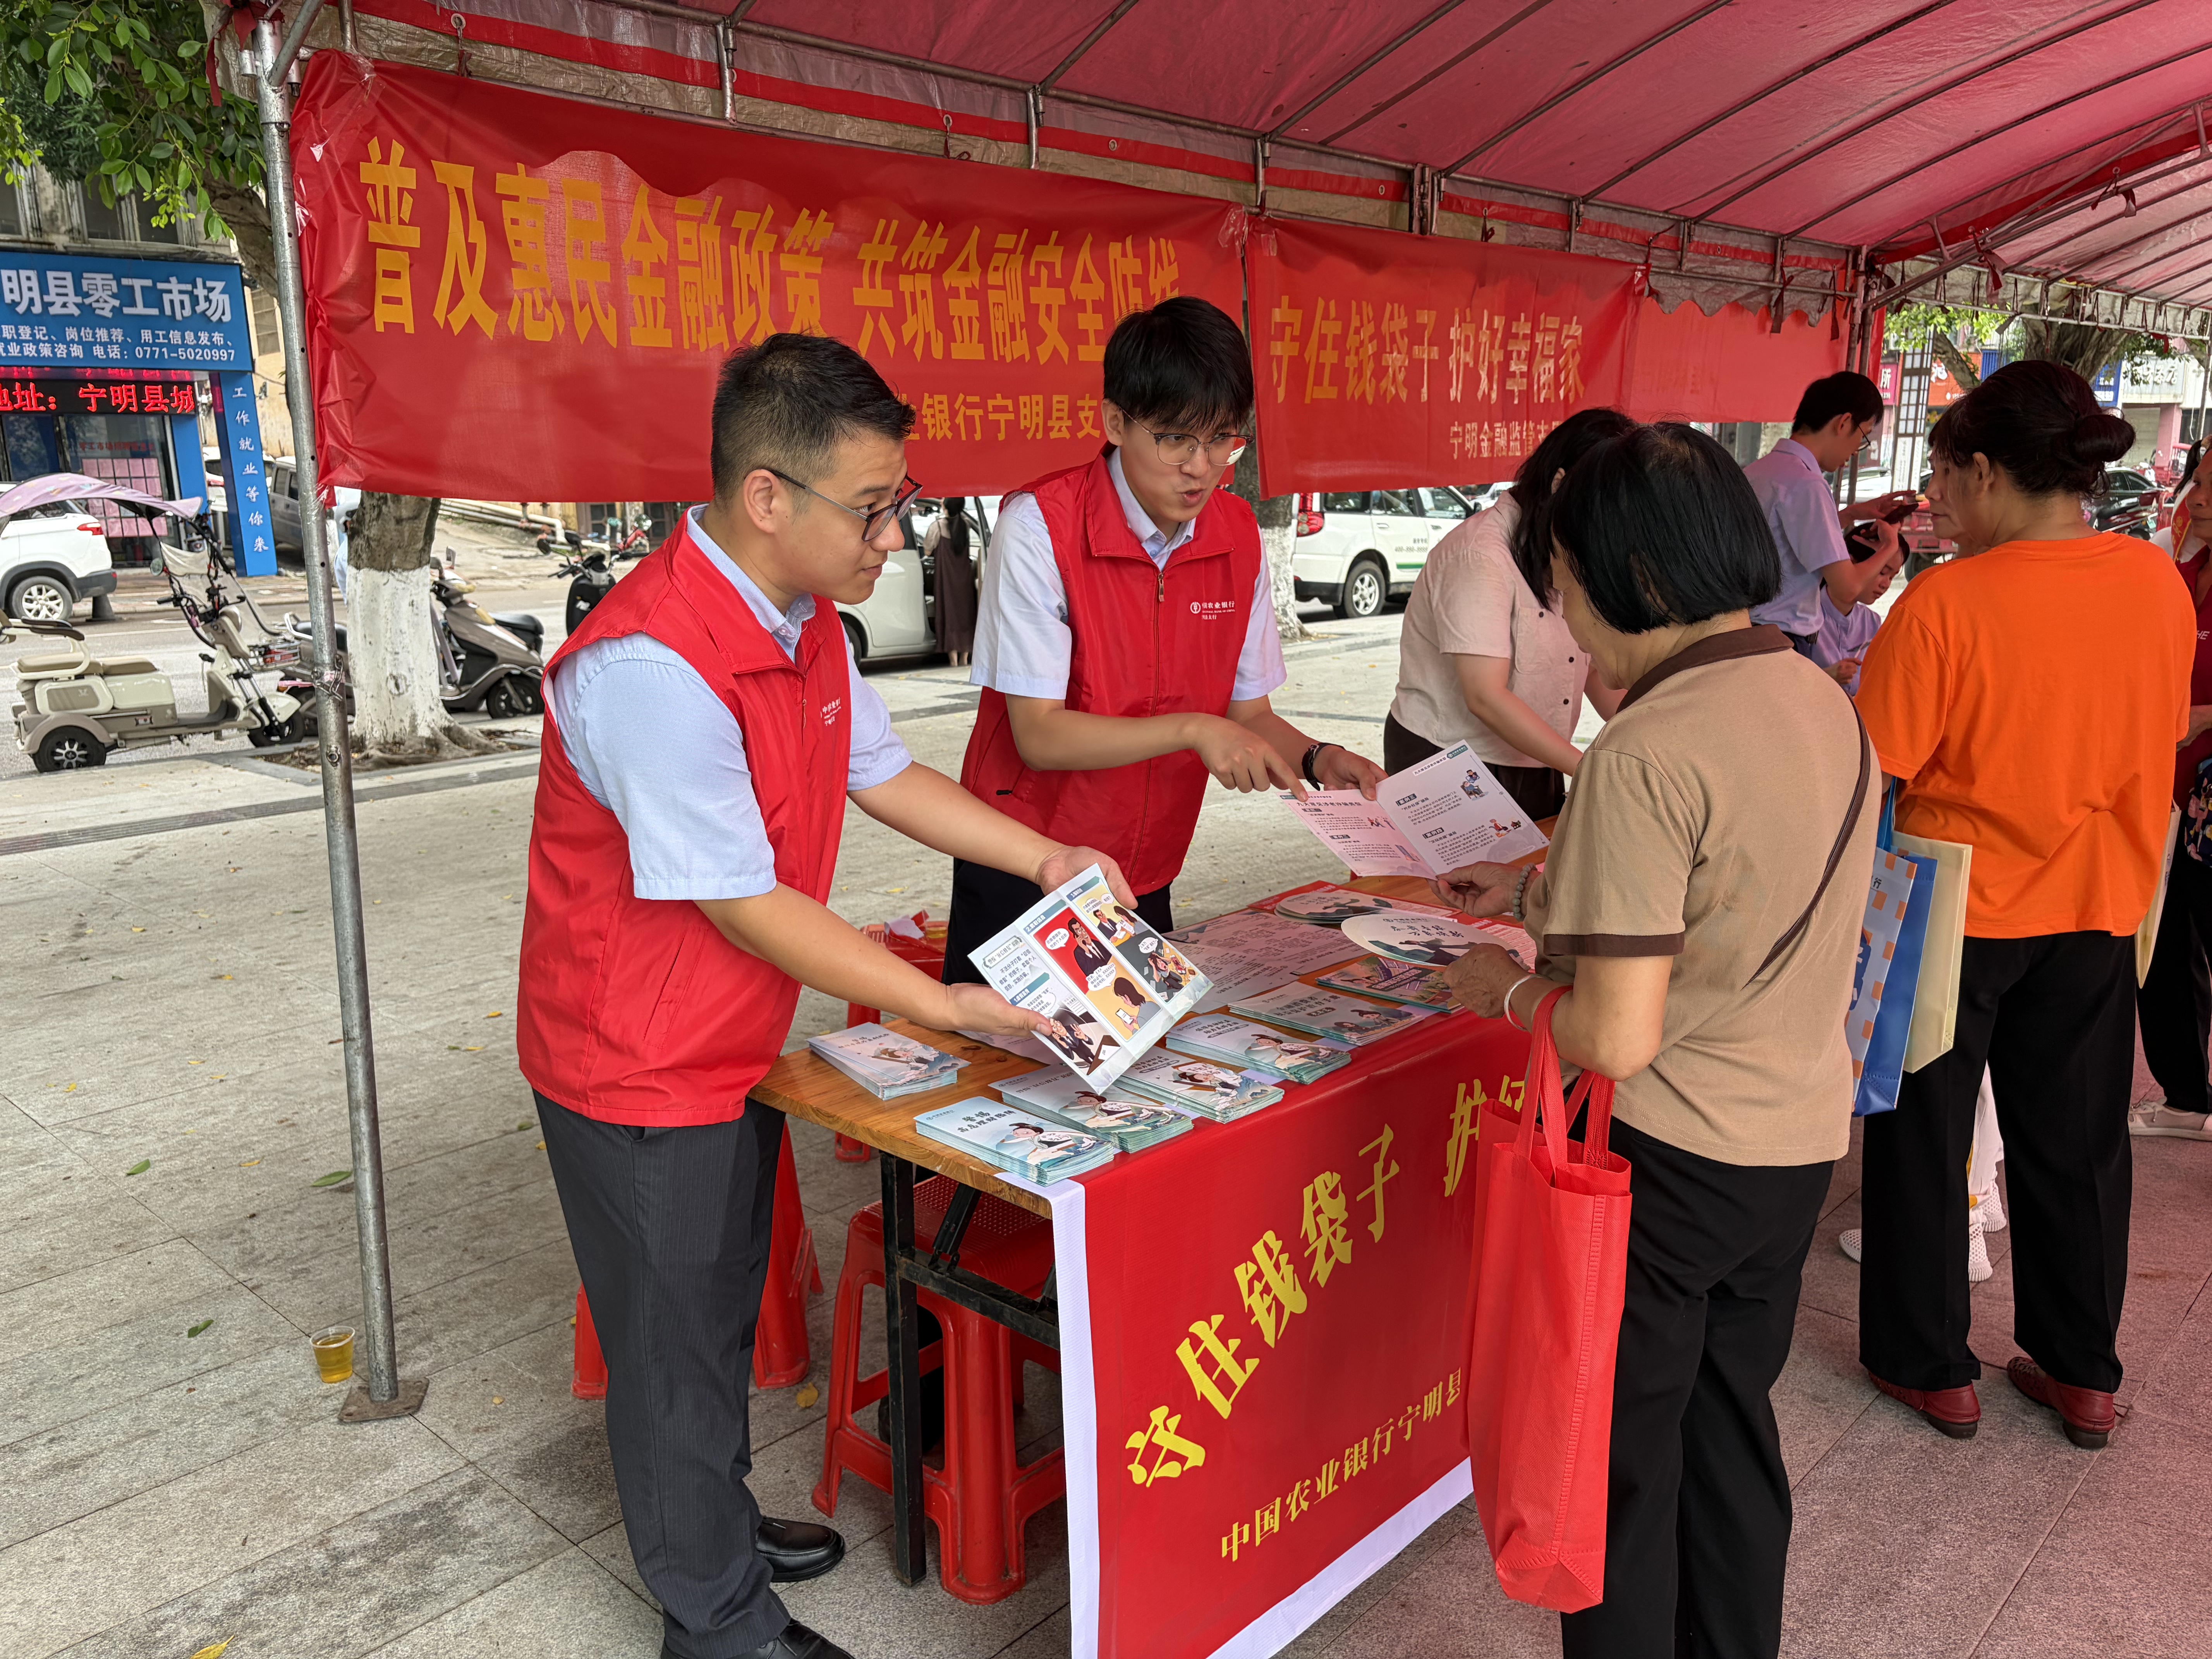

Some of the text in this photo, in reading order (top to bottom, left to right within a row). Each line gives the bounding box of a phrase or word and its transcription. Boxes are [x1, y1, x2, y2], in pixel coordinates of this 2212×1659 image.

[0, 269, 232, 323] 明县零工市场
[359, 135, 834, 352] 普及惠民金融政策
[1269, 295, 1585, 404] 守住钱袋子 护好幸福家
[1449, 420, 1563, 460] 宁明金融监管支
[1872, 876, 1882, 889] 行
[1125, 1075, 1525, 1488] 守住钱袋子 护
[1221, 1367, 1461, 1562] 中国农业银行宁明县
